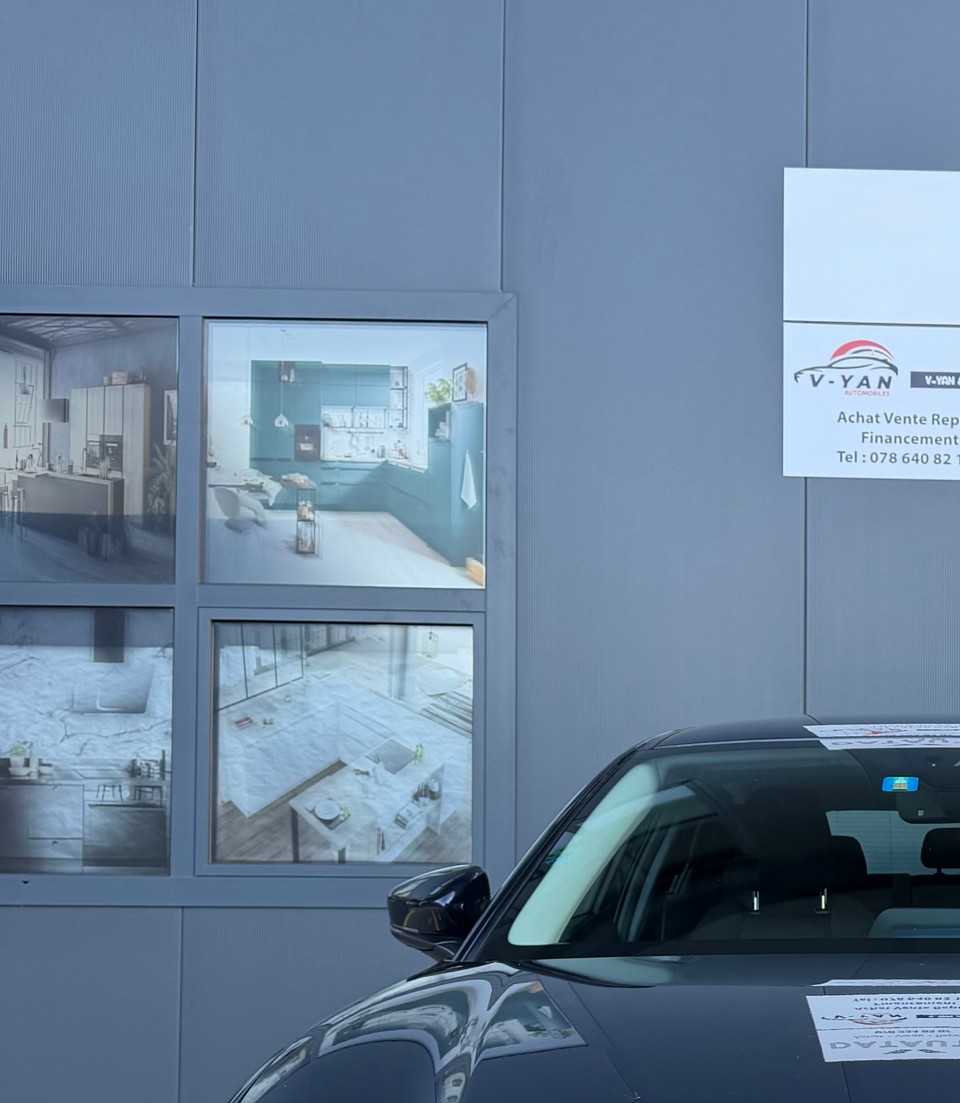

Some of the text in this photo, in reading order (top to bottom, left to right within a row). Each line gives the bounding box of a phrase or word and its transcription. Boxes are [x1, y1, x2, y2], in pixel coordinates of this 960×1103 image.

[810, 374, 892, 389] V-YAN
[924, 375, 955, 386] V-YAN
[837, 411, 880, 424] Achat
[884, 412, 927, 425] Vente
[861, 431, 959, 445] Financement
[870, 452, 897, 464] 078
[902, 453, 929, 464] 640
[933, 453, 951, 465] 82
